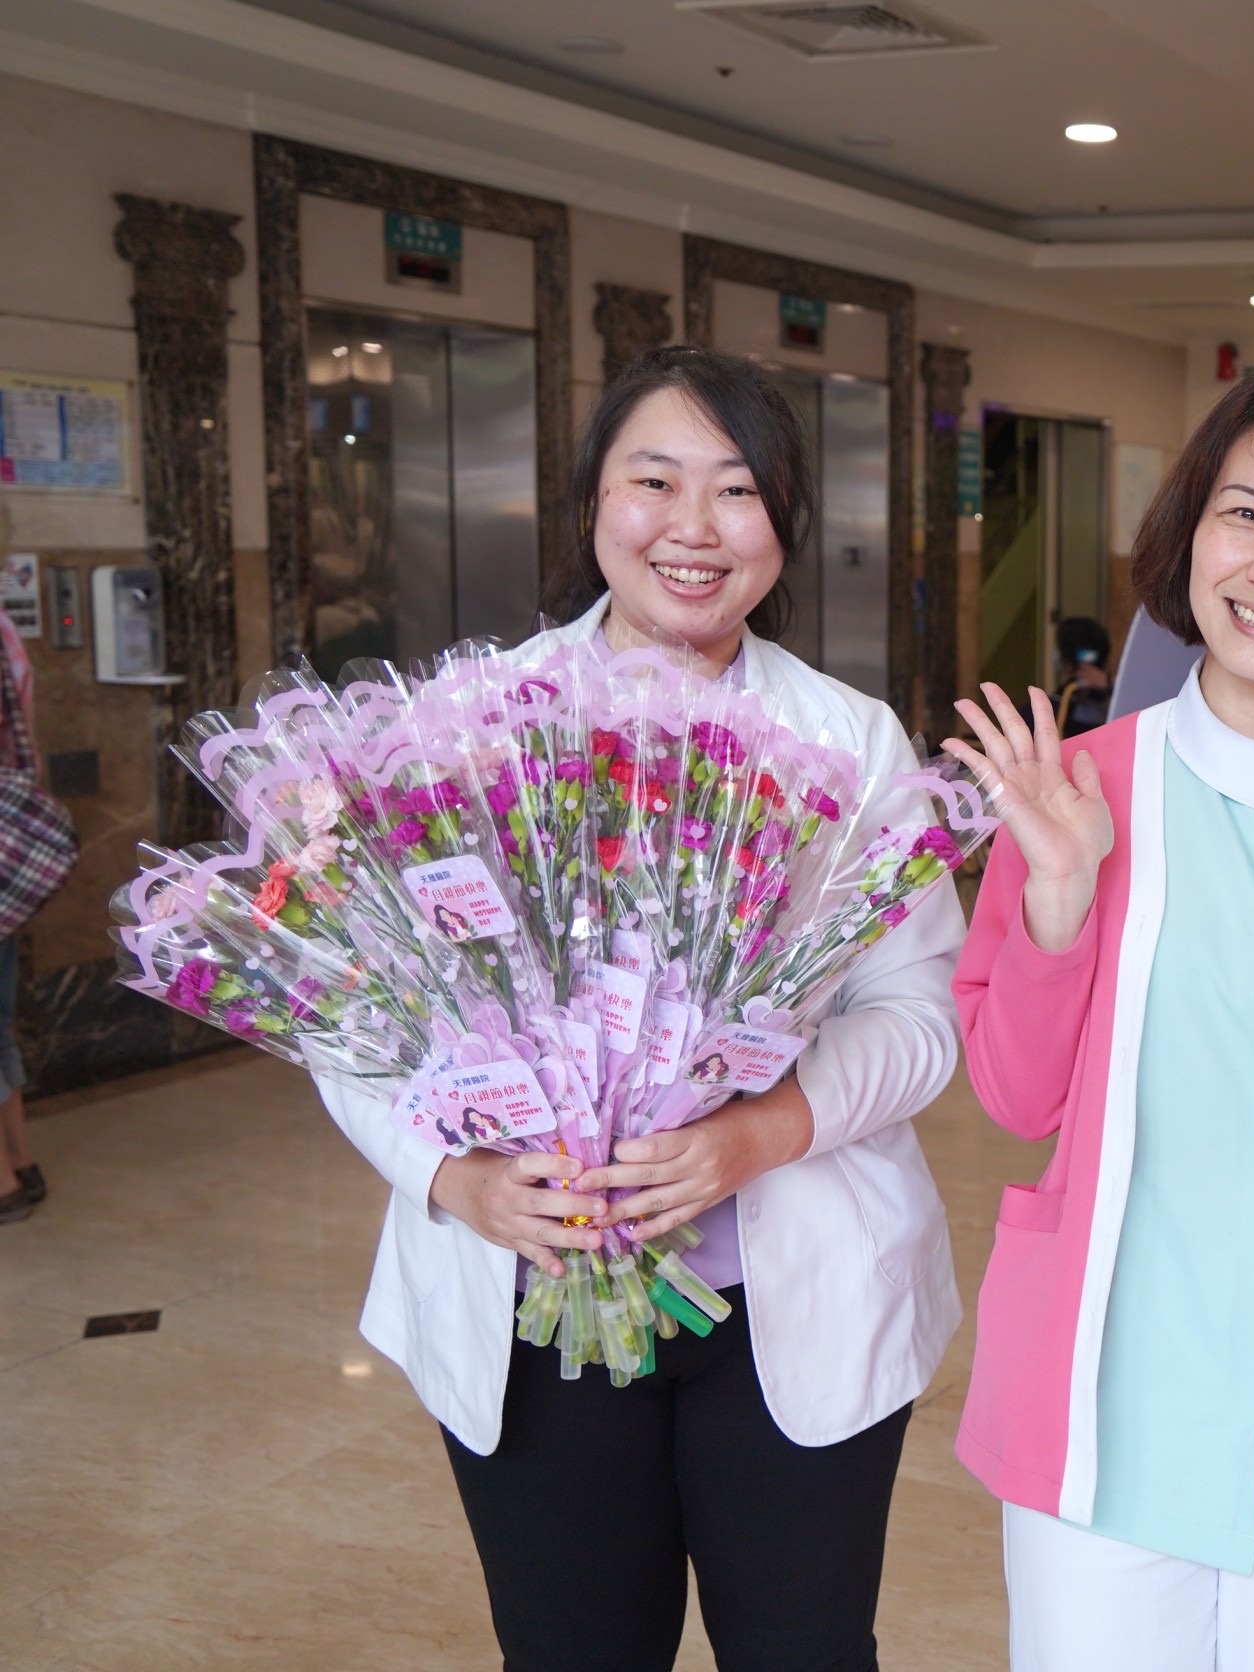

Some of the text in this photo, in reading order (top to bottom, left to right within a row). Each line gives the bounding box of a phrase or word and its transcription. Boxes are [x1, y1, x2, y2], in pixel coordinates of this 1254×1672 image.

[431, 880, 488, 902] 母親節快樂
[468, 899, 490, 909] HAPPY
[610, 953, 641, 970] 快樂
[723, 1043, 785, 1063] 母親節快樂
[746, 1062, 769, 1071] HAPPY
[452, 1074, 490, 1089] 天晟醫院
[463, 1082, 530, 1105] 母親節快樂
[505, 1100, 530, 1110] HAPPY
[513, 1118, 529, 1127] DAY
